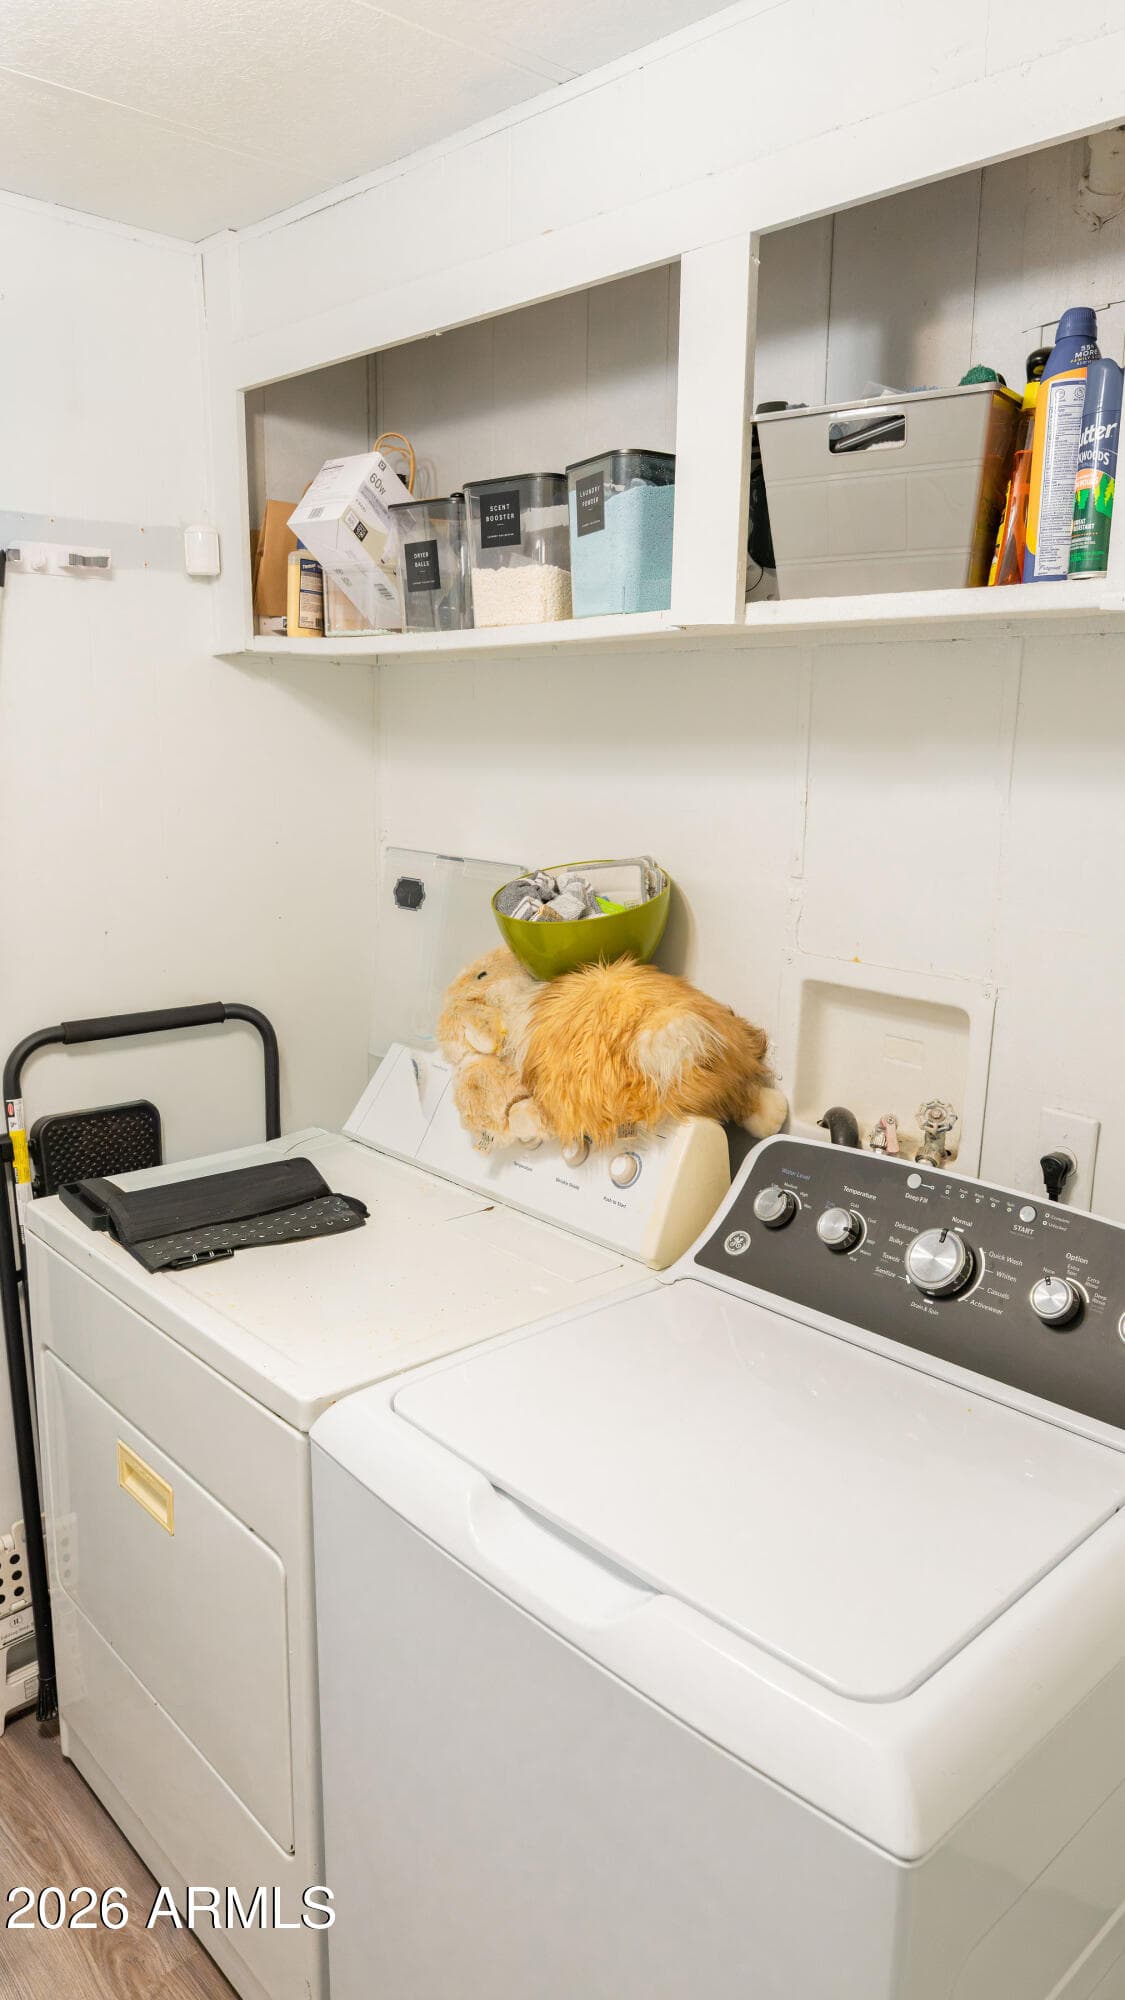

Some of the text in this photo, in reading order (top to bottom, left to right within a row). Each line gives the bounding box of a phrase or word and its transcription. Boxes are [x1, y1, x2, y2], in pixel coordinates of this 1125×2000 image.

[1074, 350, 1098, 359] MORE
[1080, 423, 1118, 446] utter
[1079, 450, 1110, 466] WOODS
[580, 486, 600, 497] LAUNDRY
[582, 496, 599, 507] POWDER
[489, 503, 510, 512] SCENT
[485, 513, 515, 522] BOOSTER
[413, 551, 429, 559] DRYER
[414, 560, 430, 568] BALLS
[843, 1185, 877, 1200] Temperature
[904, 1191, 919, 1202] Deep
[917, 1196, 930, 1204] Fill
[895, 1222, 919, 1233] Delicates
[952, 1217, 973, 1227] Normal
[1013, 1225, 1034, 1235] START
[889, 1236, 904, 1246] Bulky
[882, 1252, 901, 1263] Towels
[988, 1250, 1024, 1268] Quick Wash
[1065, 1252, 1089, 1266] Option
[1066, 1263, 1080, 1273] Extra
[996, 1271, 1017, 1282] Whites
[1086, 1276, 1100, 1286] Extra
[987, 1288, 1010, 1300] Casuals
[928, 1306, 940, 1317] Spin
[970, 1299, 1004, 1315] Activewear
